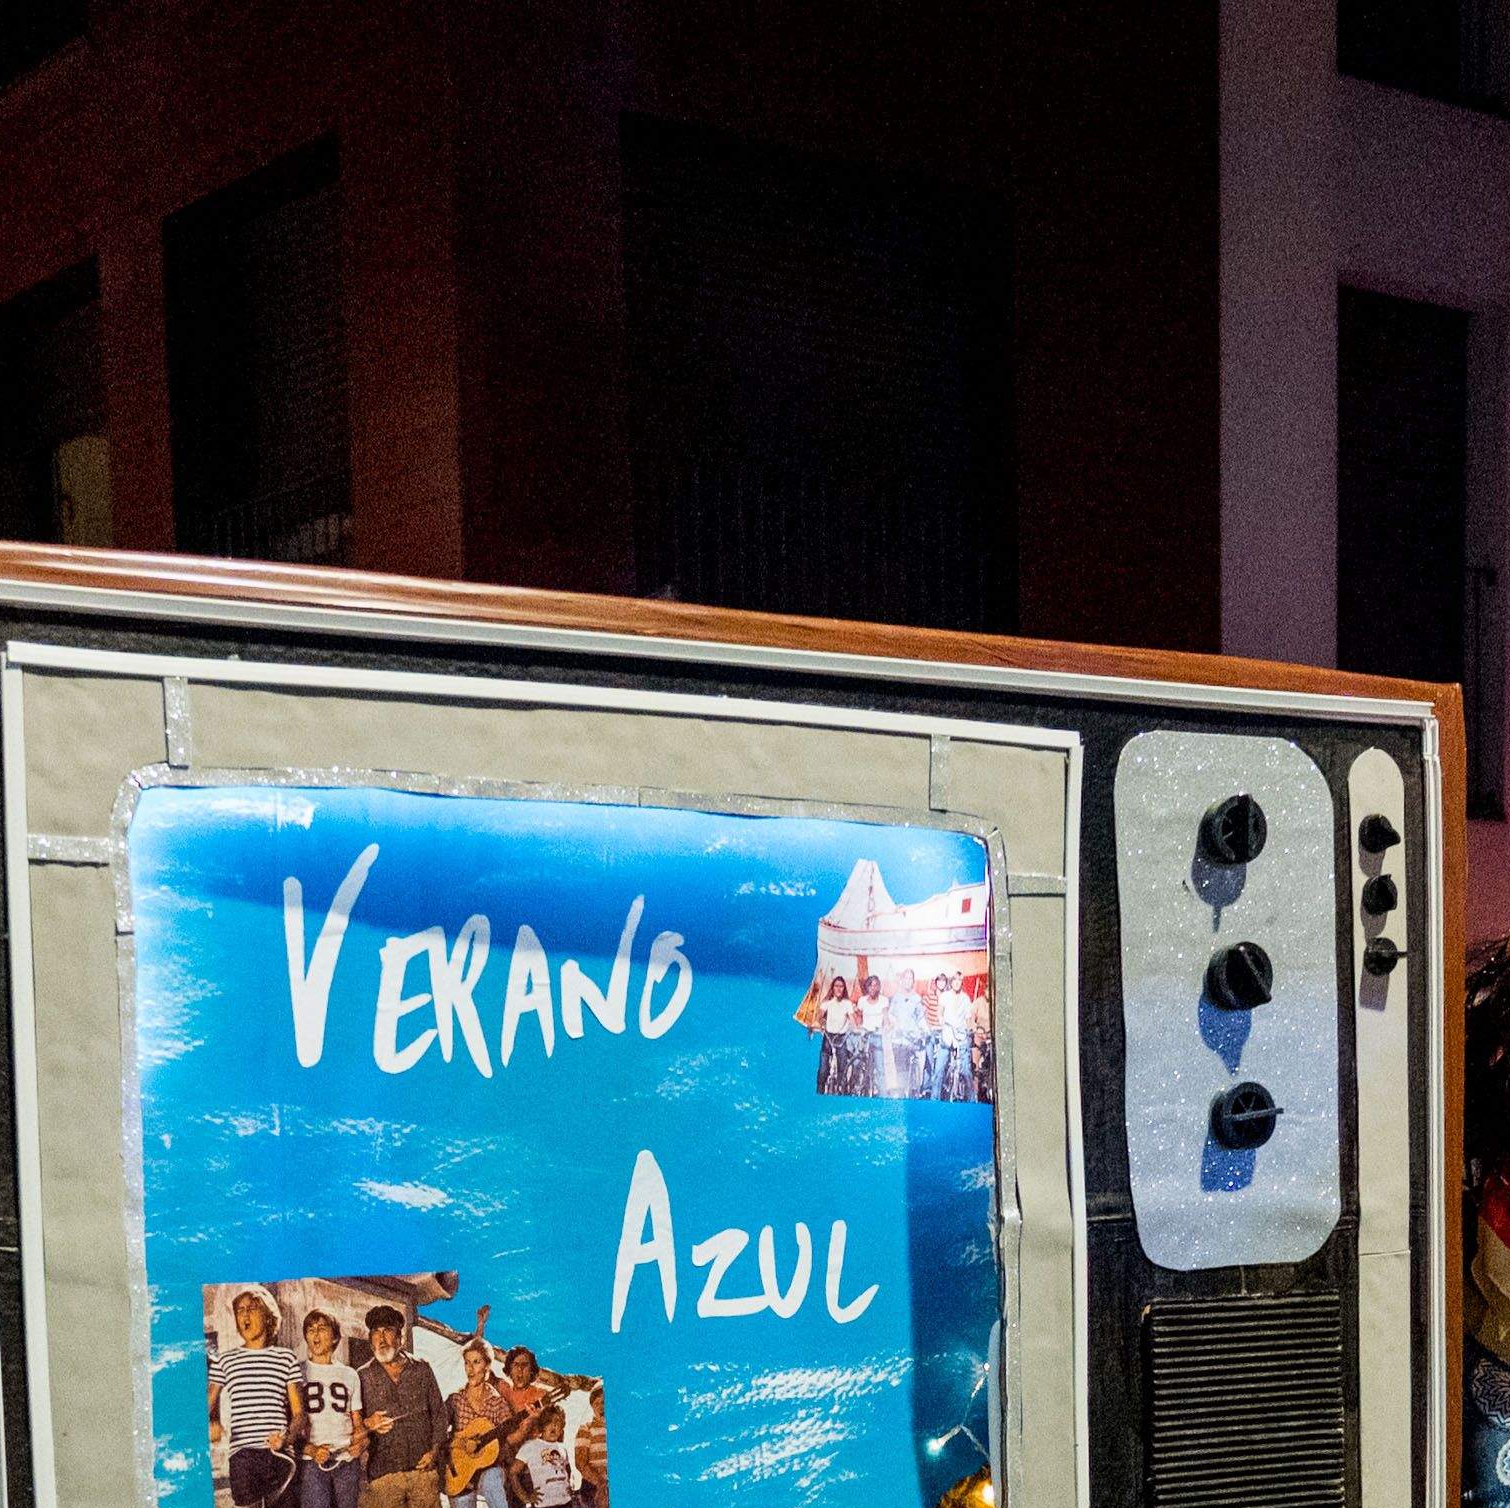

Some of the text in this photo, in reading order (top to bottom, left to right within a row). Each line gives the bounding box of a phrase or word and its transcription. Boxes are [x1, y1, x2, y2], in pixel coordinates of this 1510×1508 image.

[283, 842, 694, 1078] VERANO
[611, 1149, 880, 1334] AZUL
[304, 1381, 349, 1414] 89
